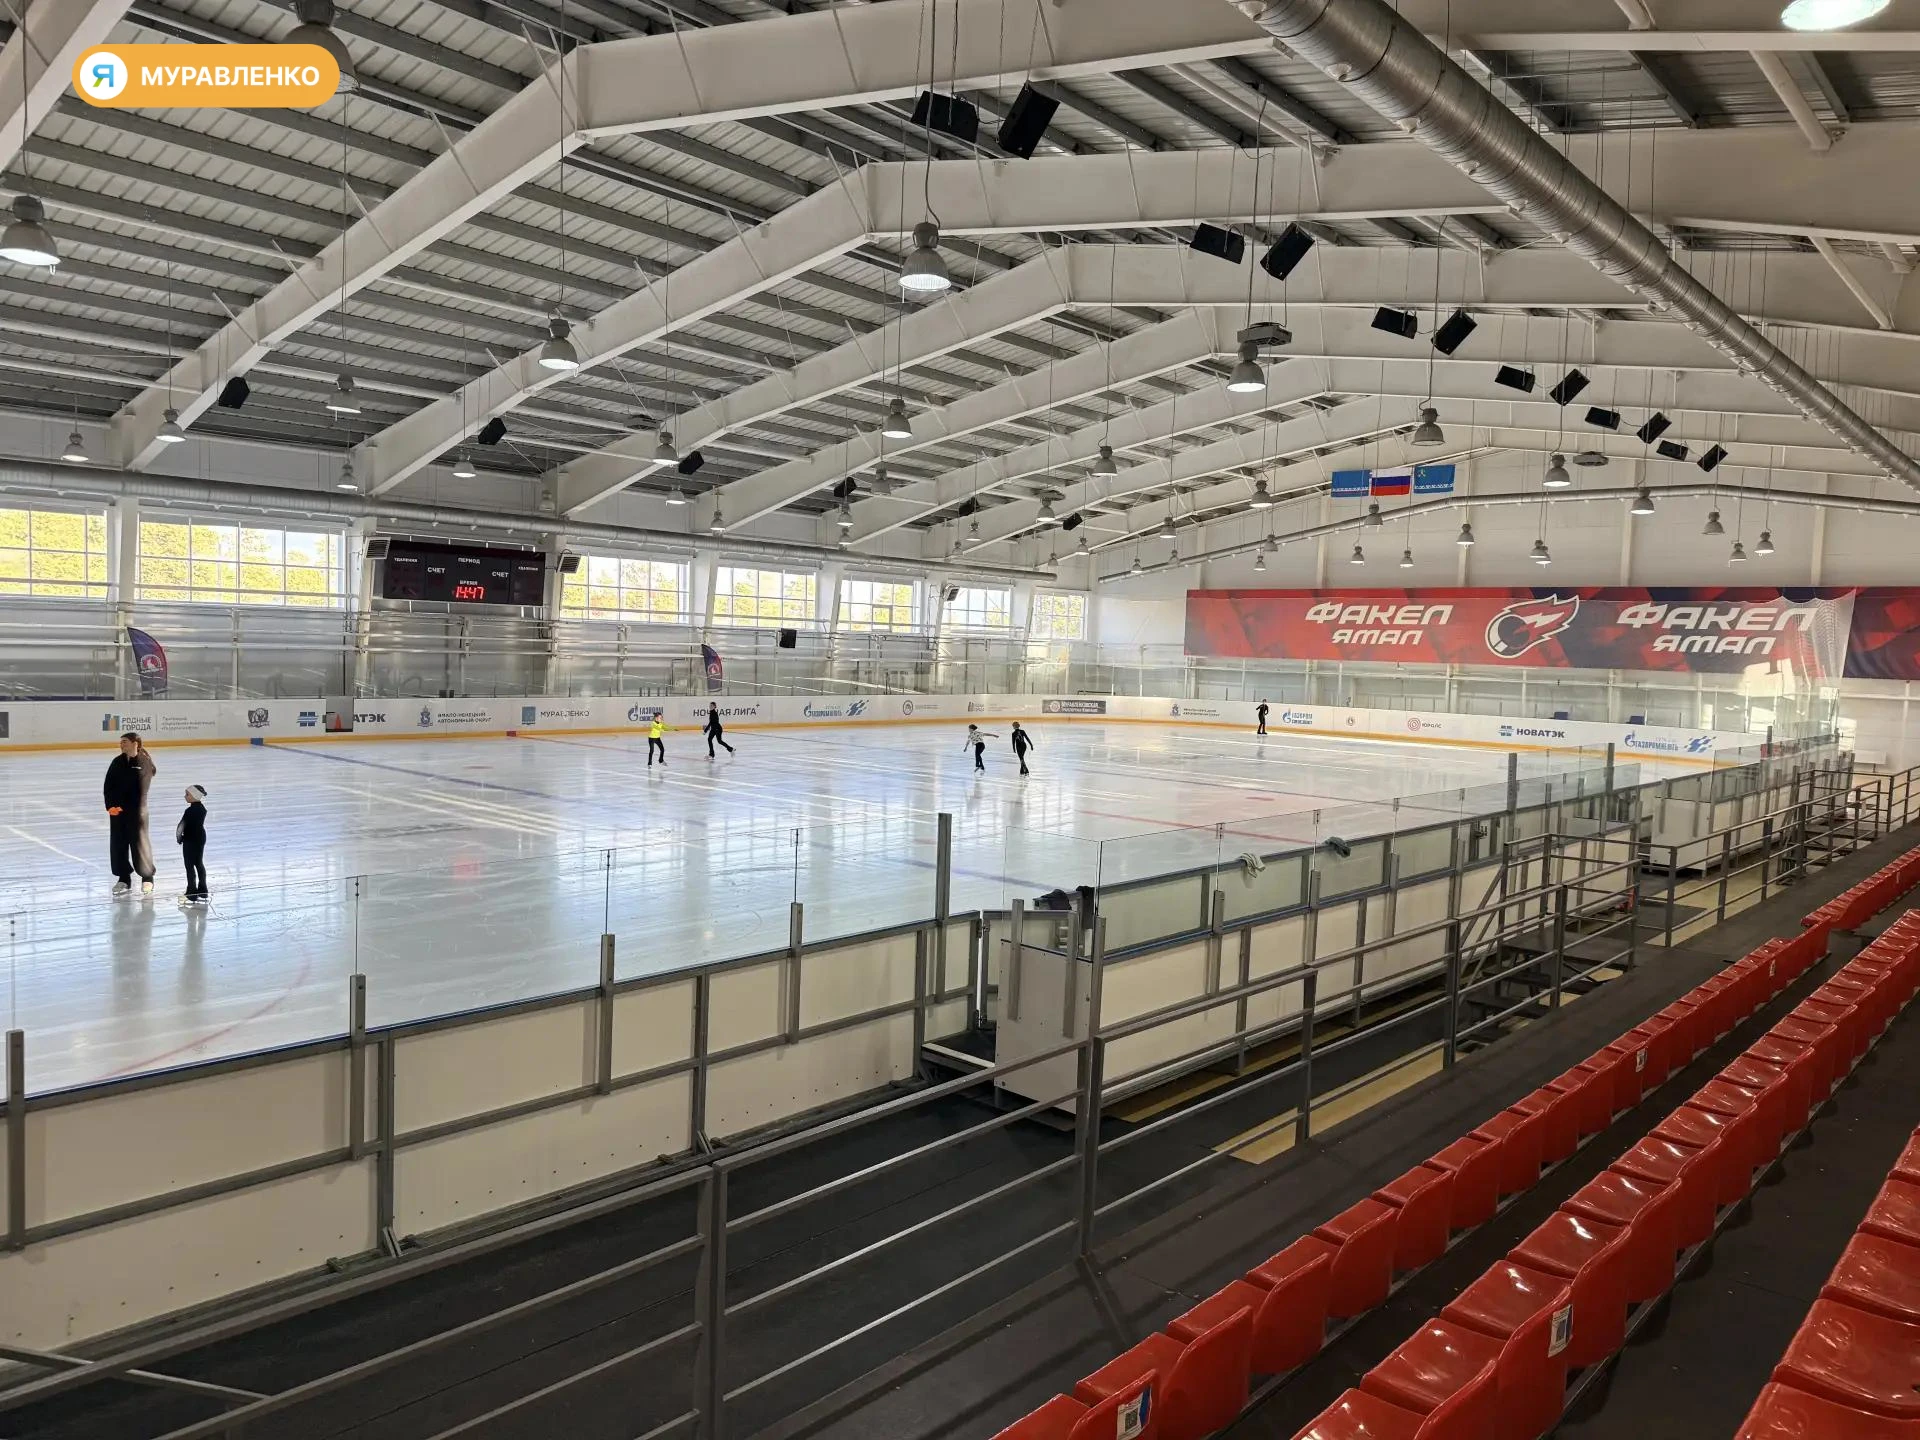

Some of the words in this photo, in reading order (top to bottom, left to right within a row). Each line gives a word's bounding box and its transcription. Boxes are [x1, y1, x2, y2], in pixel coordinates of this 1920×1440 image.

[458, 557, 481, 565] ПЕРИОД
[1305, 602, 1454, 625] ФАКЕЛ
[1617, 603, 1819, 632] ФАКЕЛ
[1332, 629, 1423, 645] ЯМАЛ
[1652, 635, 1776, 655] ЯМАЛ
[733, 707, 757, 716] ЛИГА
[1516, 727, 1565, 739] НОВАТЭК
